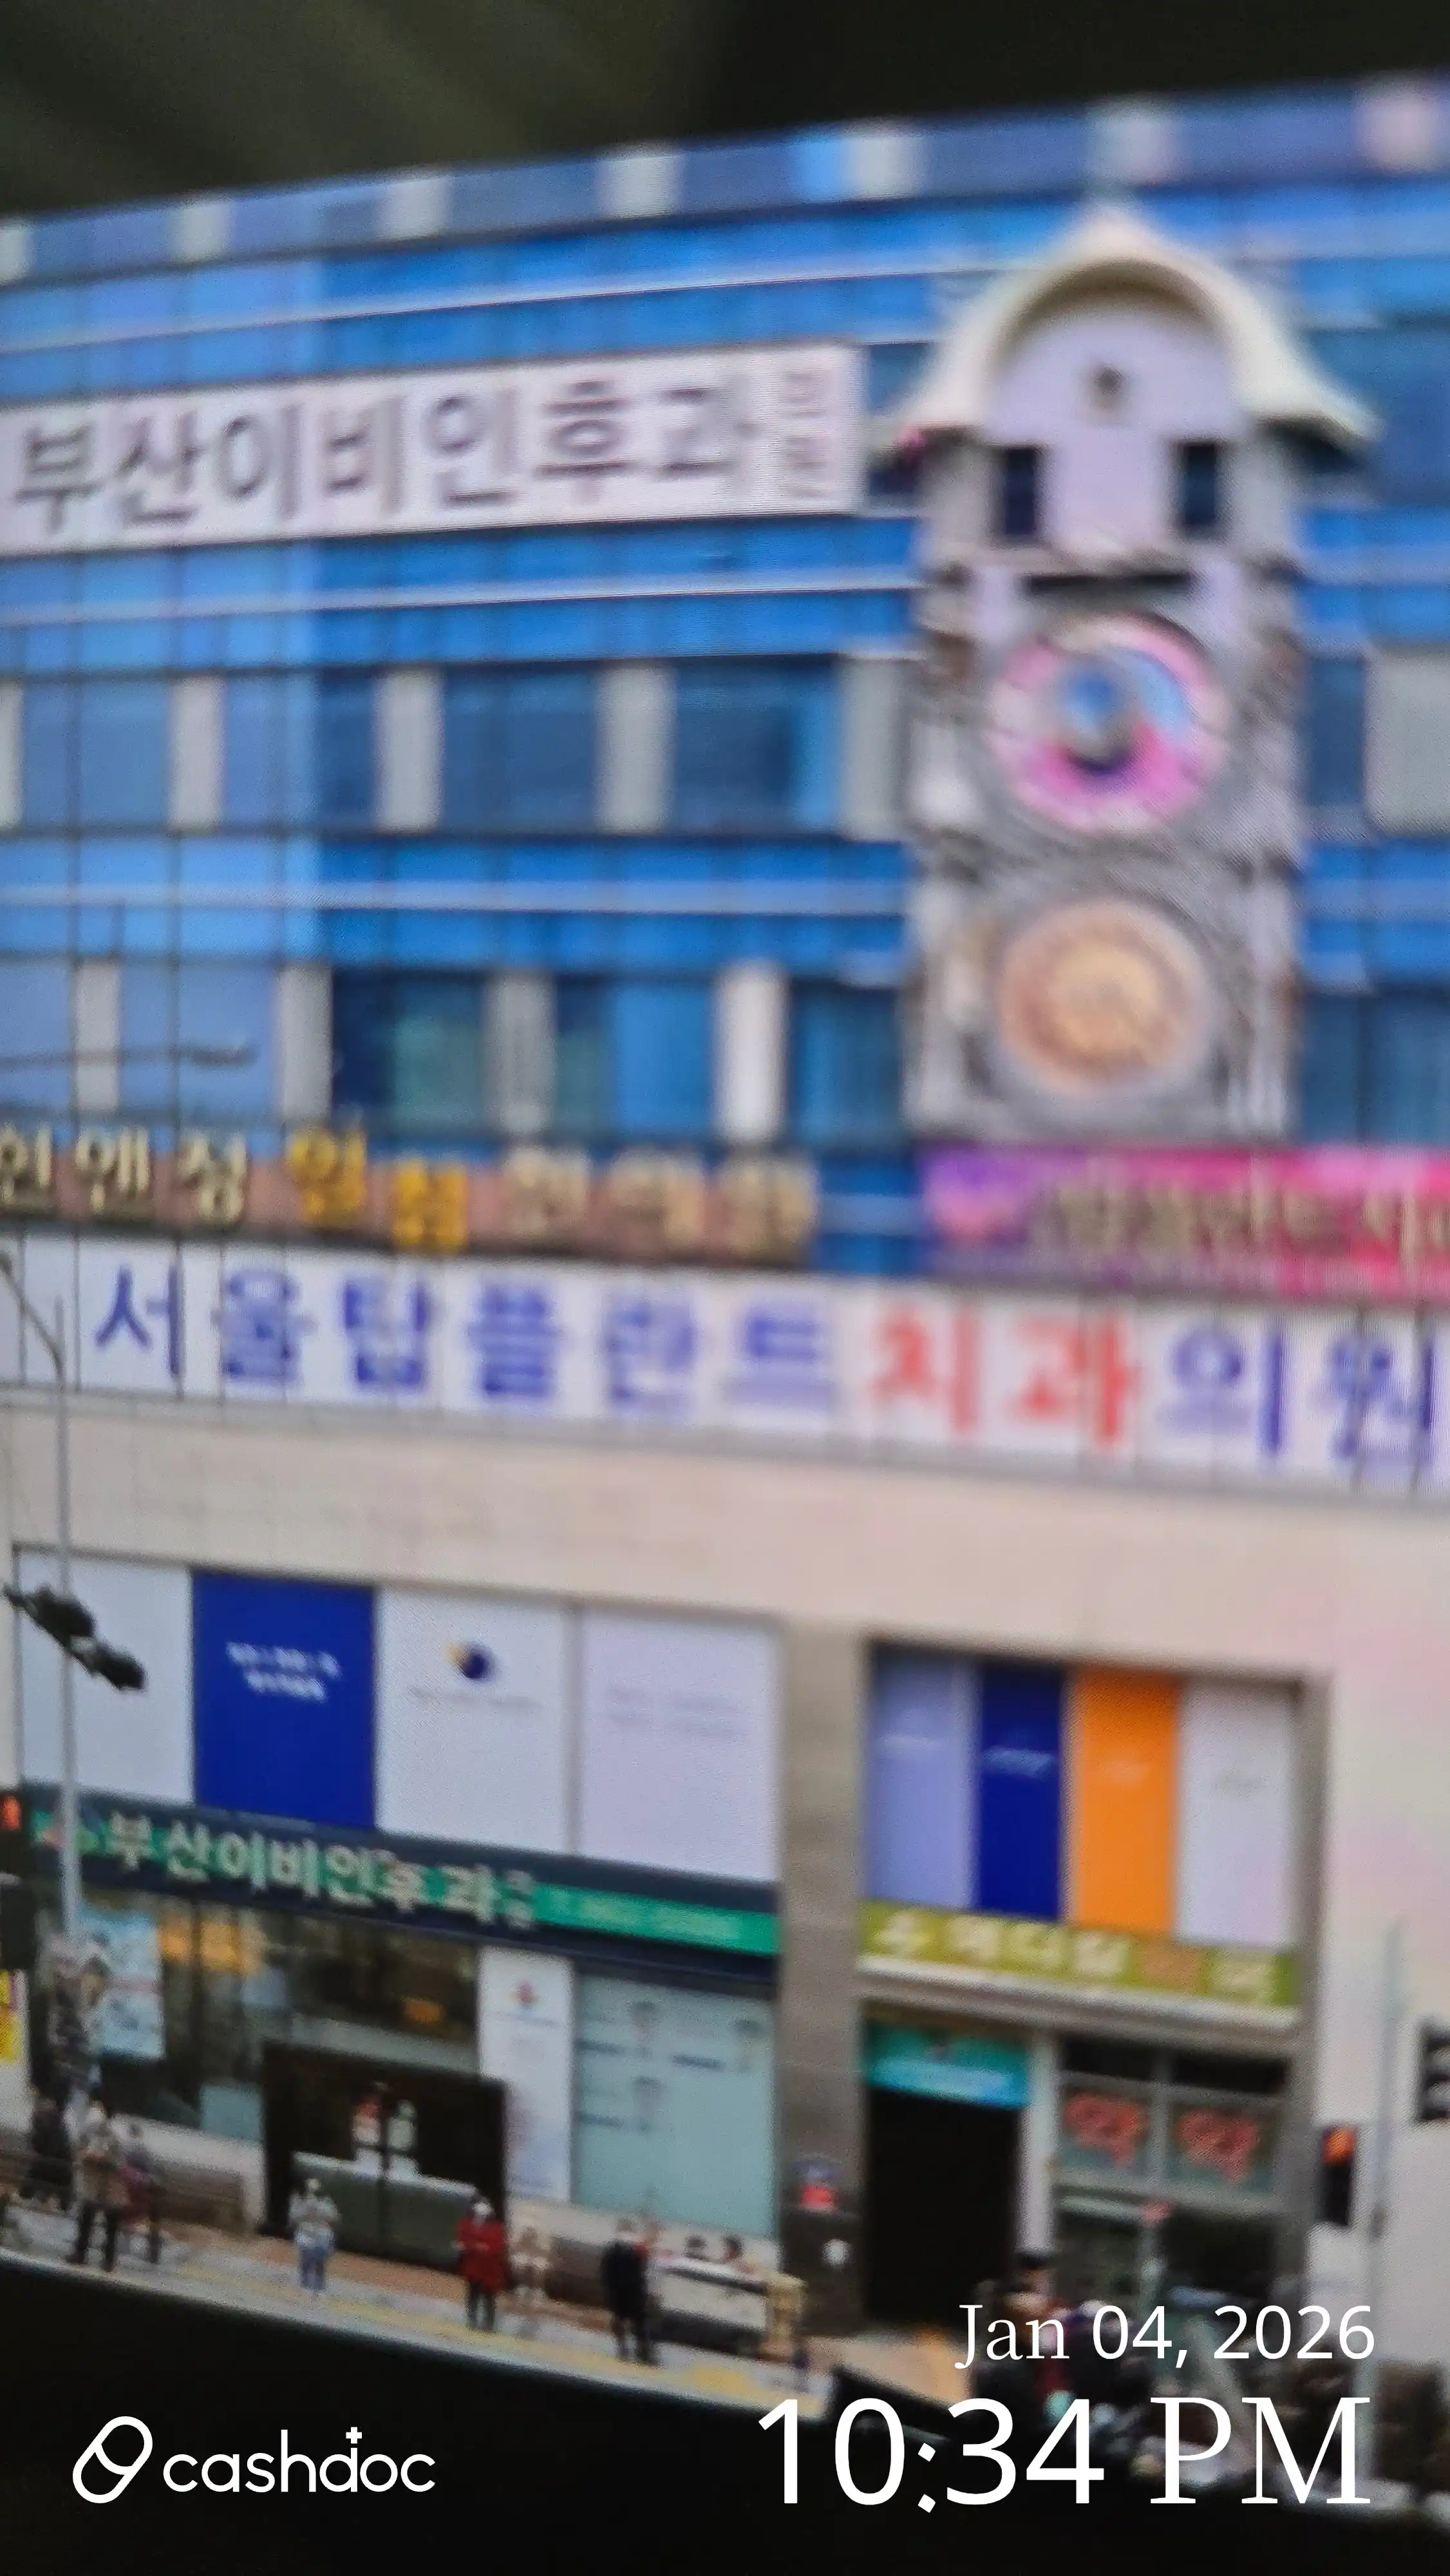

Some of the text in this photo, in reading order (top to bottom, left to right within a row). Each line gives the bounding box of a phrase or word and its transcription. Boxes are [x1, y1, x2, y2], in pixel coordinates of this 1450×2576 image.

[13, 372, 765, 533] 부산이비인후과
[95, 1262, 1449, 1467] 서울탑플란트치과의원
[104, 1812, 501, 1926] 부산이비인후과
